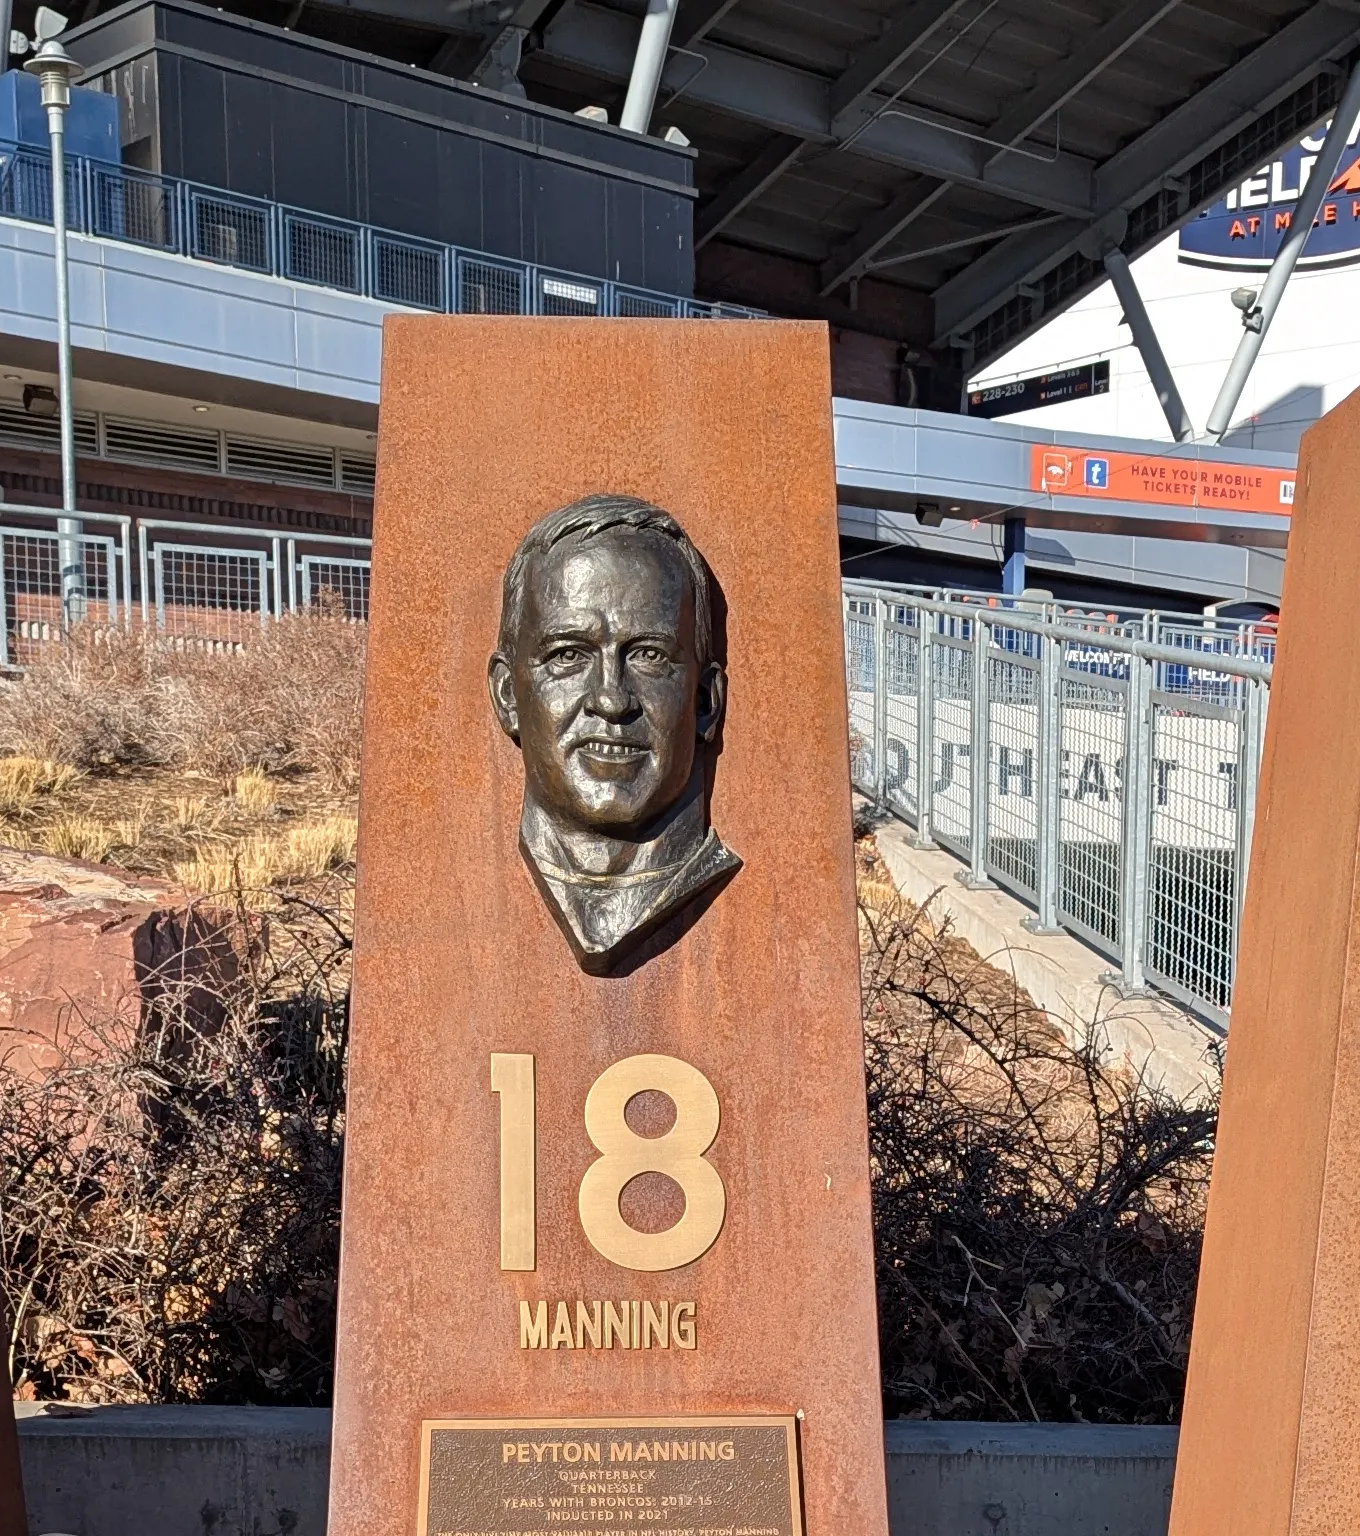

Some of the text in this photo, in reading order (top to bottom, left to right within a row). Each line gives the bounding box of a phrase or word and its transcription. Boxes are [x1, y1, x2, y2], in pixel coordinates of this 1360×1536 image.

[1229, 217, 1260, 240] AT
[1276, 204, 1337, 232] ME
[983, 382, 1025, 402] 228-230
[1131, 465, 1262, 488] HAVE YOUR MOBILE
[1143, 480, 1251, 501] TICKETS READY!
[491, 1052, 727, 1272] 18
[520, 1299, 698, 1351] MANNING
[502, 1441, 736, 1463] PEYTON MANNING
[559, 1469, 657, 1481] QUARTERBACK
[571, 1483, 644, 1494] TENNESSEE
[503, 1496, 714, 1509] YEARS WITH BRONCOS: 2012-15
[546, 1510, 668, 1522] INDUCTED IN 2021
[699, 1528, 733, 1536] PEYTON
[735, 1528, 779, 1536] MANNING
